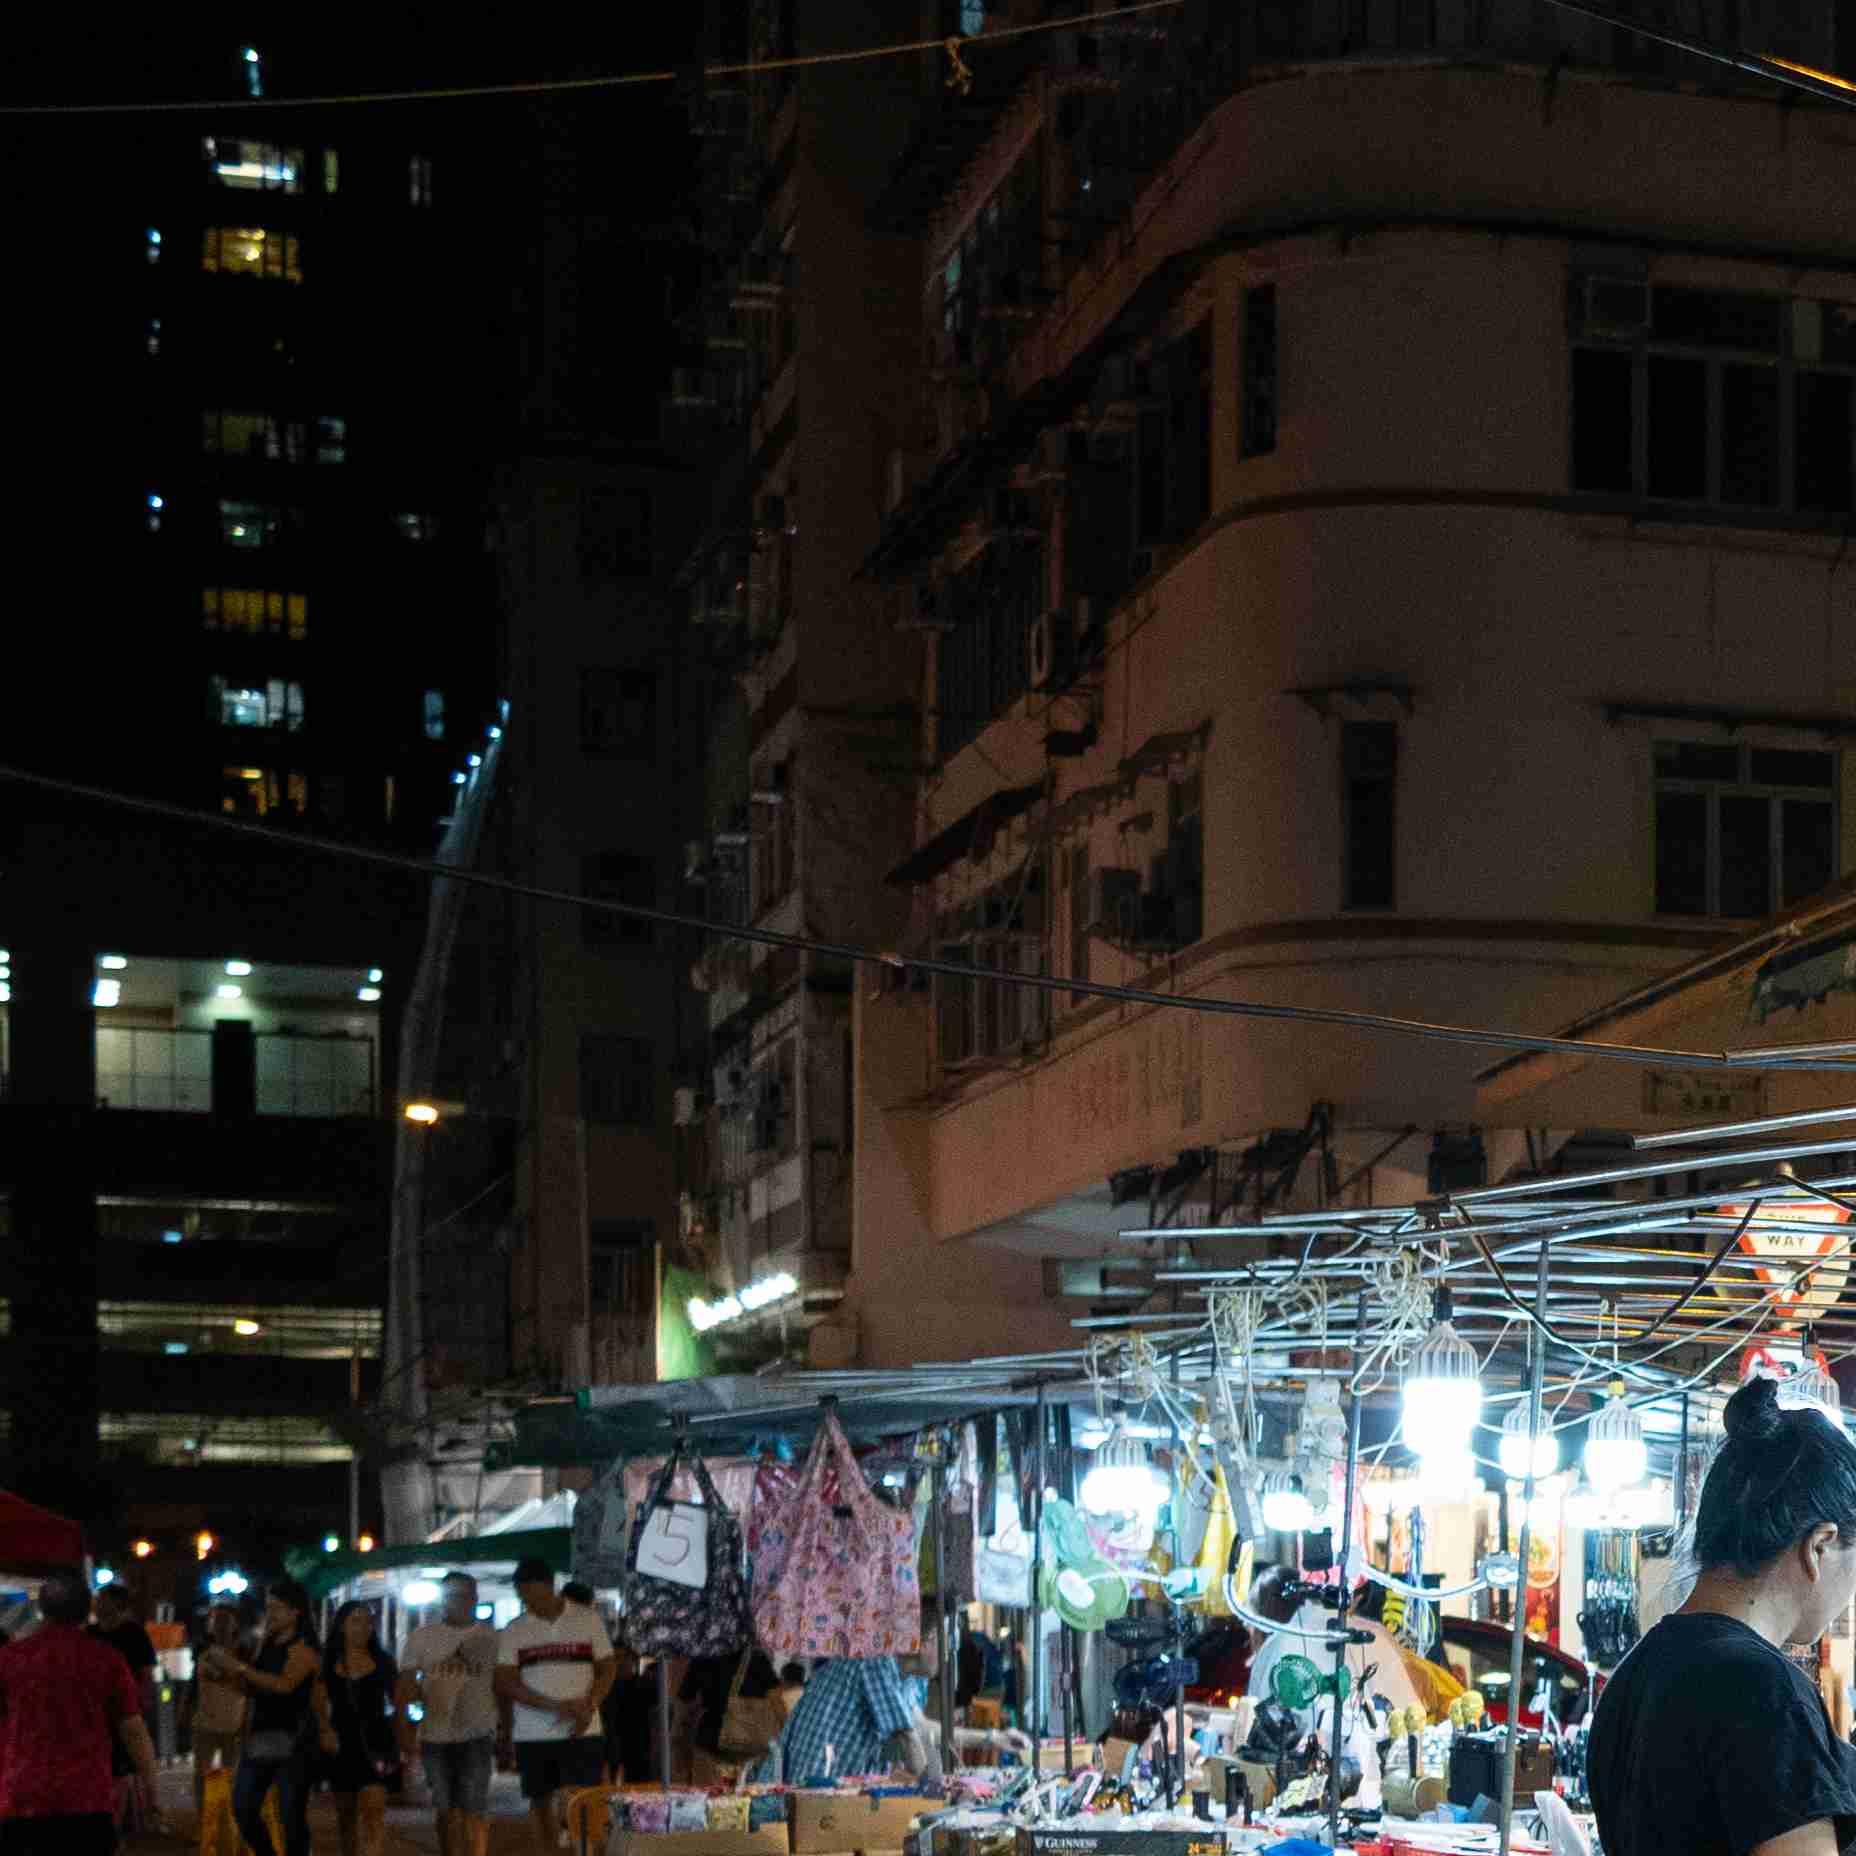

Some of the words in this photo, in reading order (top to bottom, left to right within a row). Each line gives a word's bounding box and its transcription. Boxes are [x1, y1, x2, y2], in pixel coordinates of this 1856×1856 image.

[1767, 1234, 1805, 1247] WAY
[651, 1506, 696, 1565] 5
[1044, 1837, 1099, 1850] GUINNESS
